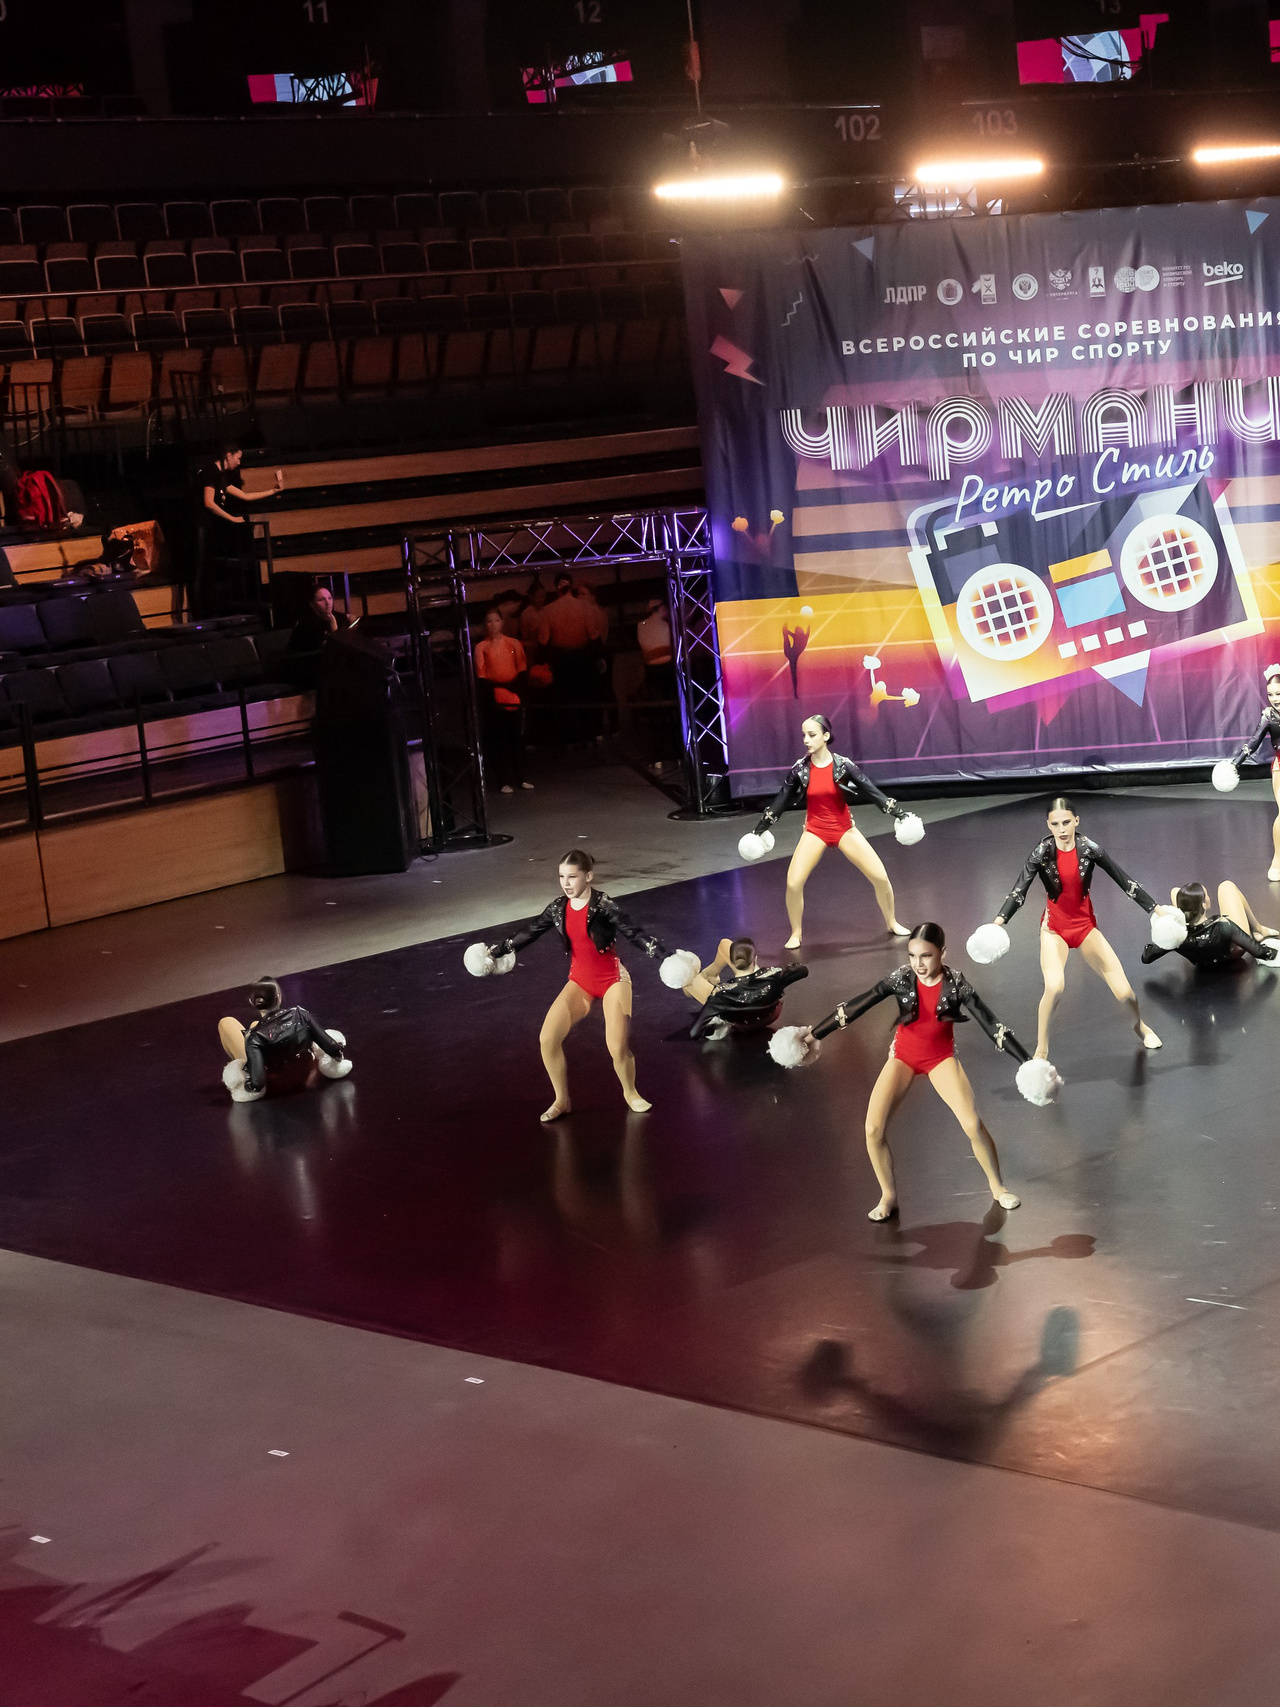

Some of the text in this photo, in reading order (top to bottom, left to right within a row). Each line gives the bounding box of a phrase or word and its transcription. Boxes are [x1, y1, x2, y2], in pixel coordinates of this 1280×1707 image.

[302, 0, 328, 23] 11
[574, 0, 603, 23] 12
[834, 114, 882, 141] 102
[1202, 261, 1244, 277] beko
[884, 285, 927, 305] ЛДПР
[842, 325, 1067, 355] ВСЕРОССИЙСКИЕ
[962, 338, 1173, 368] ПО ЧИР СПОРТУ
[954, 446, 1215, 522] Ретро Стиль
